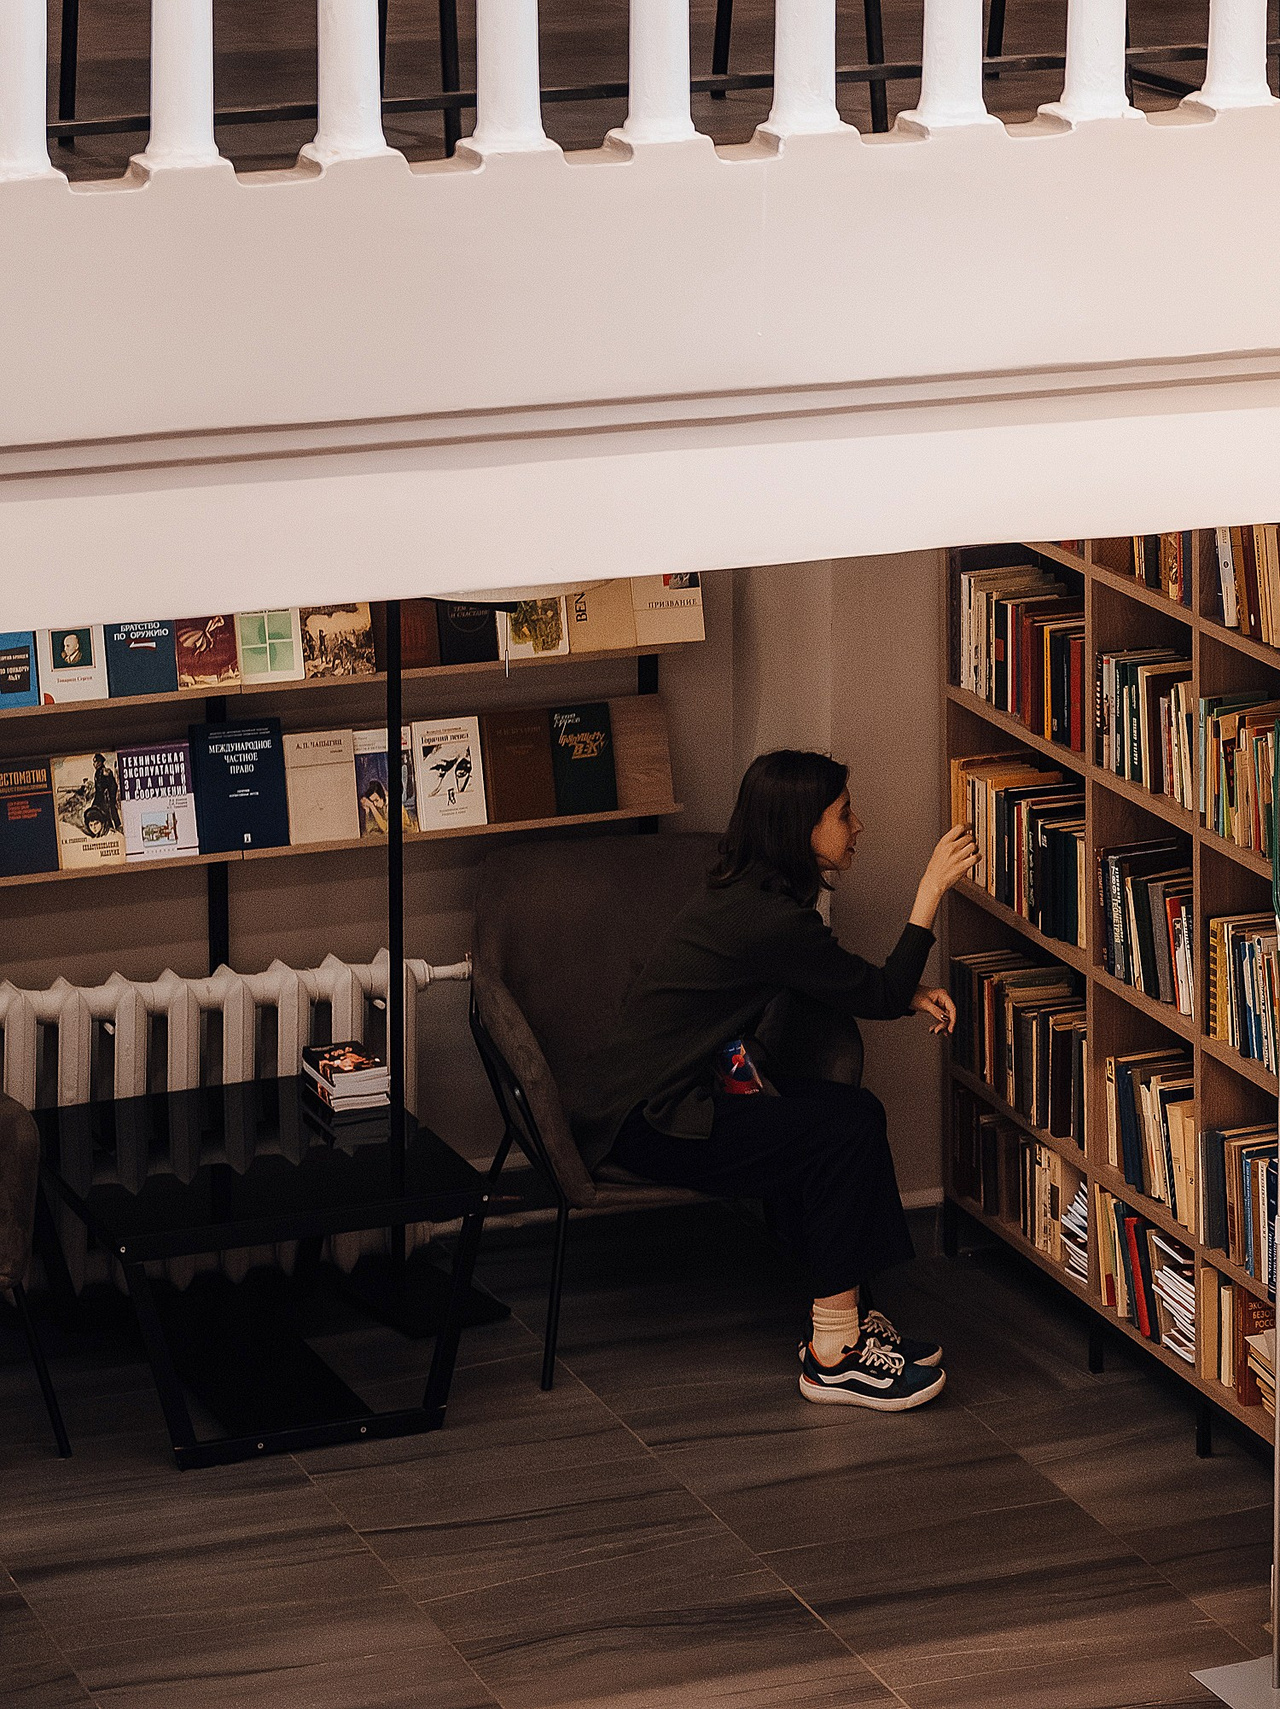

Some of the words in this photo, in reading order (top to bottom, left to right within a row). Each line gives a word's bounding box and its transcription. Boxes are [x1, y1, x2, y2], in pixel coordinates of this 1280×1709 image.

[648, 599, 697, 609] ПРИЗВАНИЕ
[120, 622, 160, 632] БРАТСТВО
[114, 633, 126, 641] ПО
[130, 628, 169, 639] ОРУЖИЮ
[208, 739, 272, 754] МЕЖДУНАРОДНОЕ
[122, 751, 185, 768] ТЕХНИЧЕСКАЯ
[224, 752, 259, 764] ЧАСТНОЕ
[123, 763, 186, 779] ЭКСПЛУАТАЦИЯ
[230, 763, 255, 775] ПРАВО
[125, 790, 131, 801] И
[134, 785, 187, 800] СООРУЖЕНИЙ
[1112, 898, 1121, 943] ГЕОМЕТРИЯ
[1189, 1177, 1194, 1185] 2
[1248, 1301, 1263, 1310] ЭКО
[1255, 1319, 1276, 1328] РОСС
